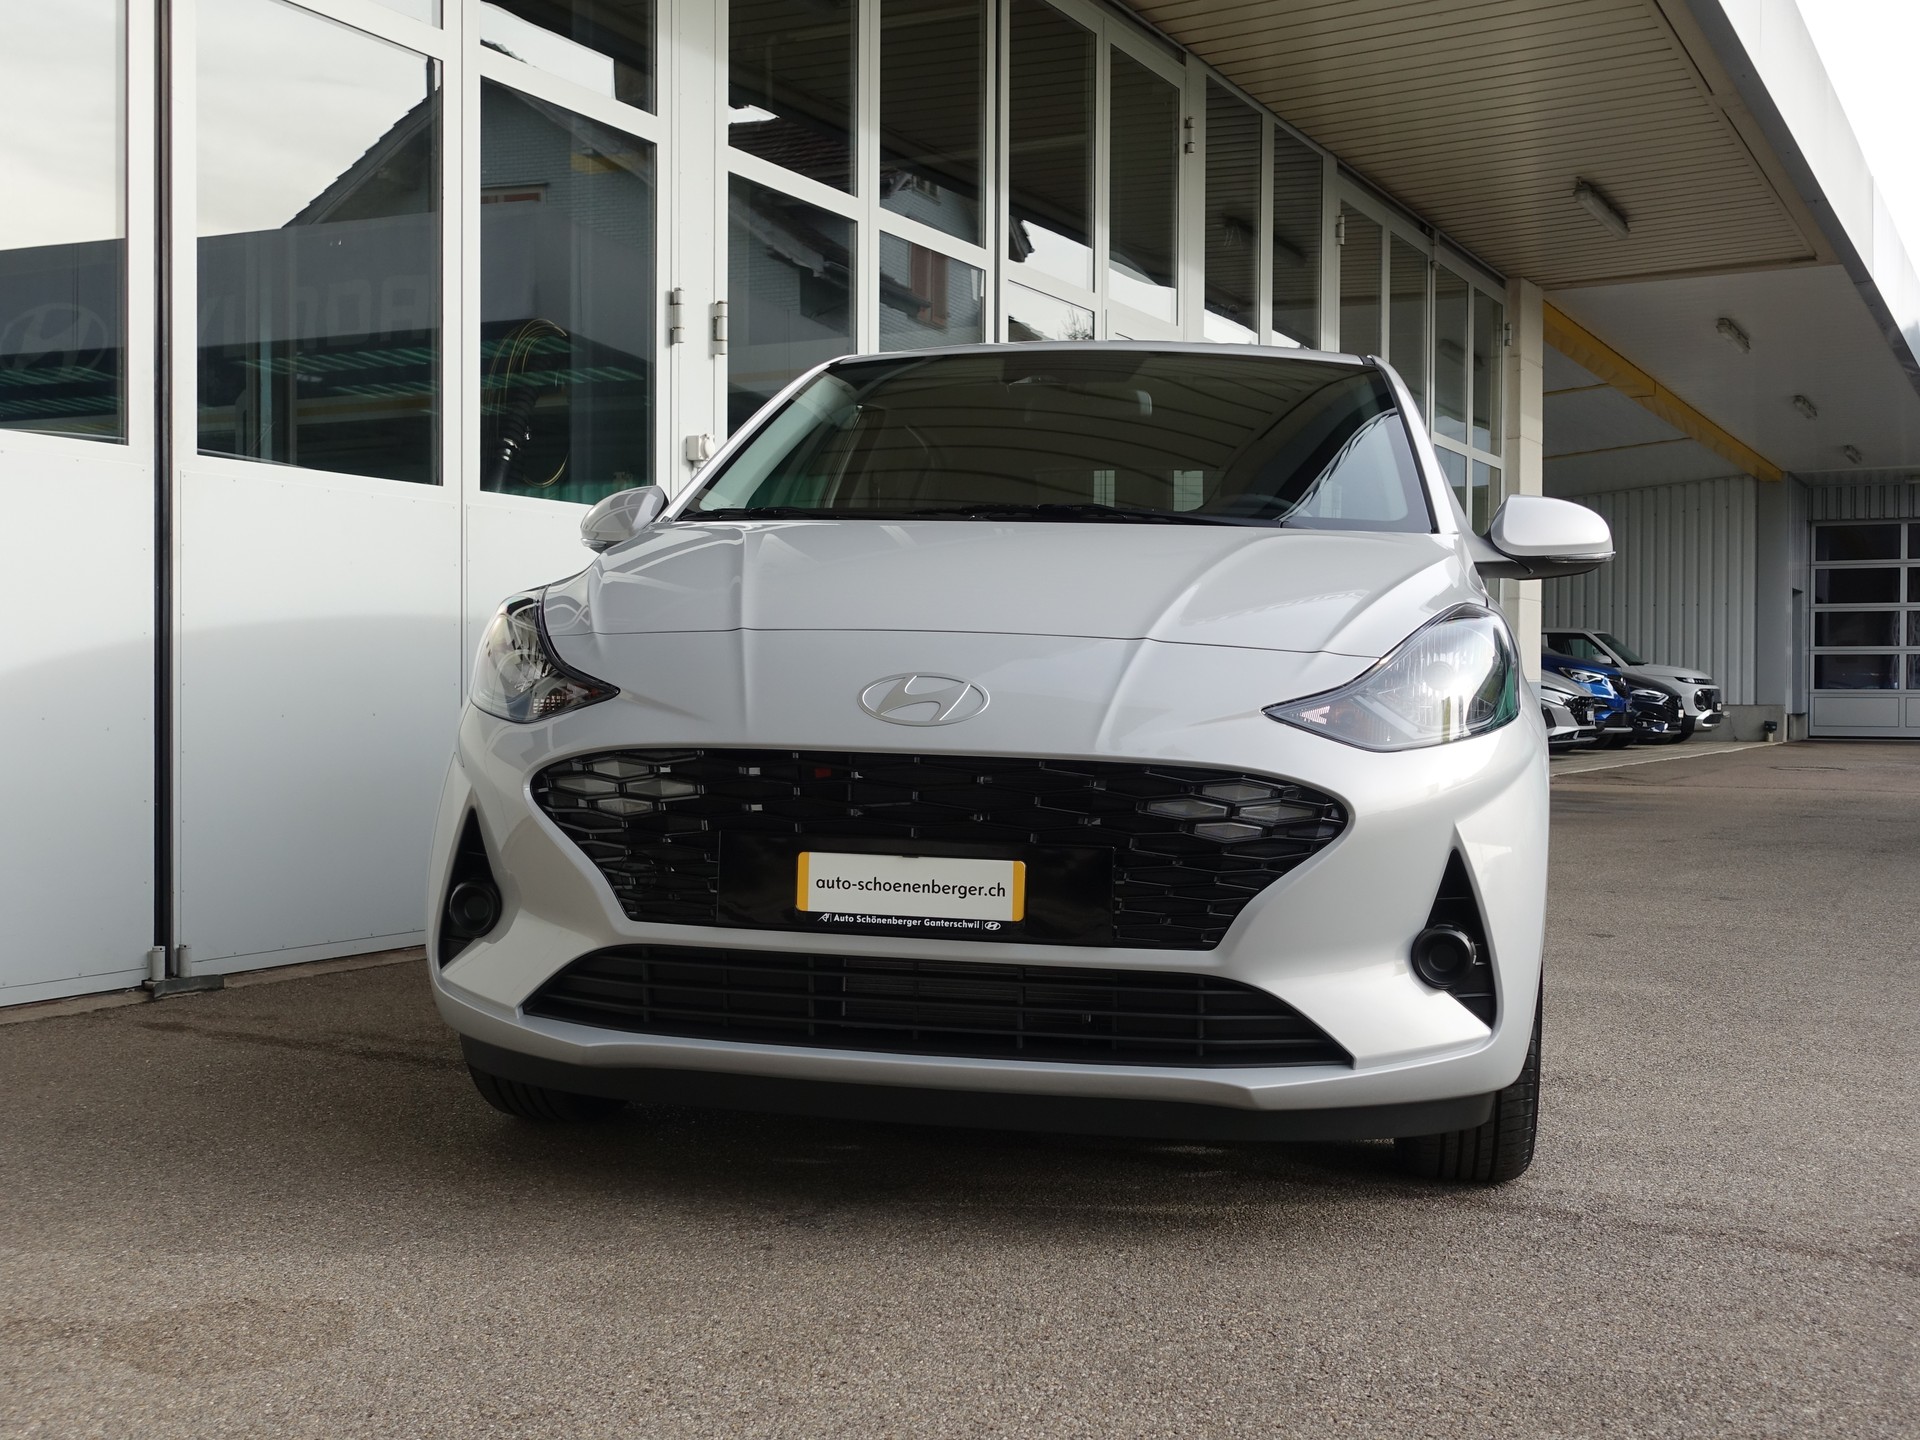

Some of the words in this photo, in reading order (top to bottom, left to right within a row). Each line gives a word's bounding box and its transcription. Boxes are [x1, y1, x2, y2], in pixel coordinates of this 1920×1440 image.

[815, 876, 1007, 899] auto-schoenenberger.ch
[833, 913, 855, 923] Auto
[856, 914, 922, 928] Schönenberger
[923, 918, 980, 929] Ganterschwil
